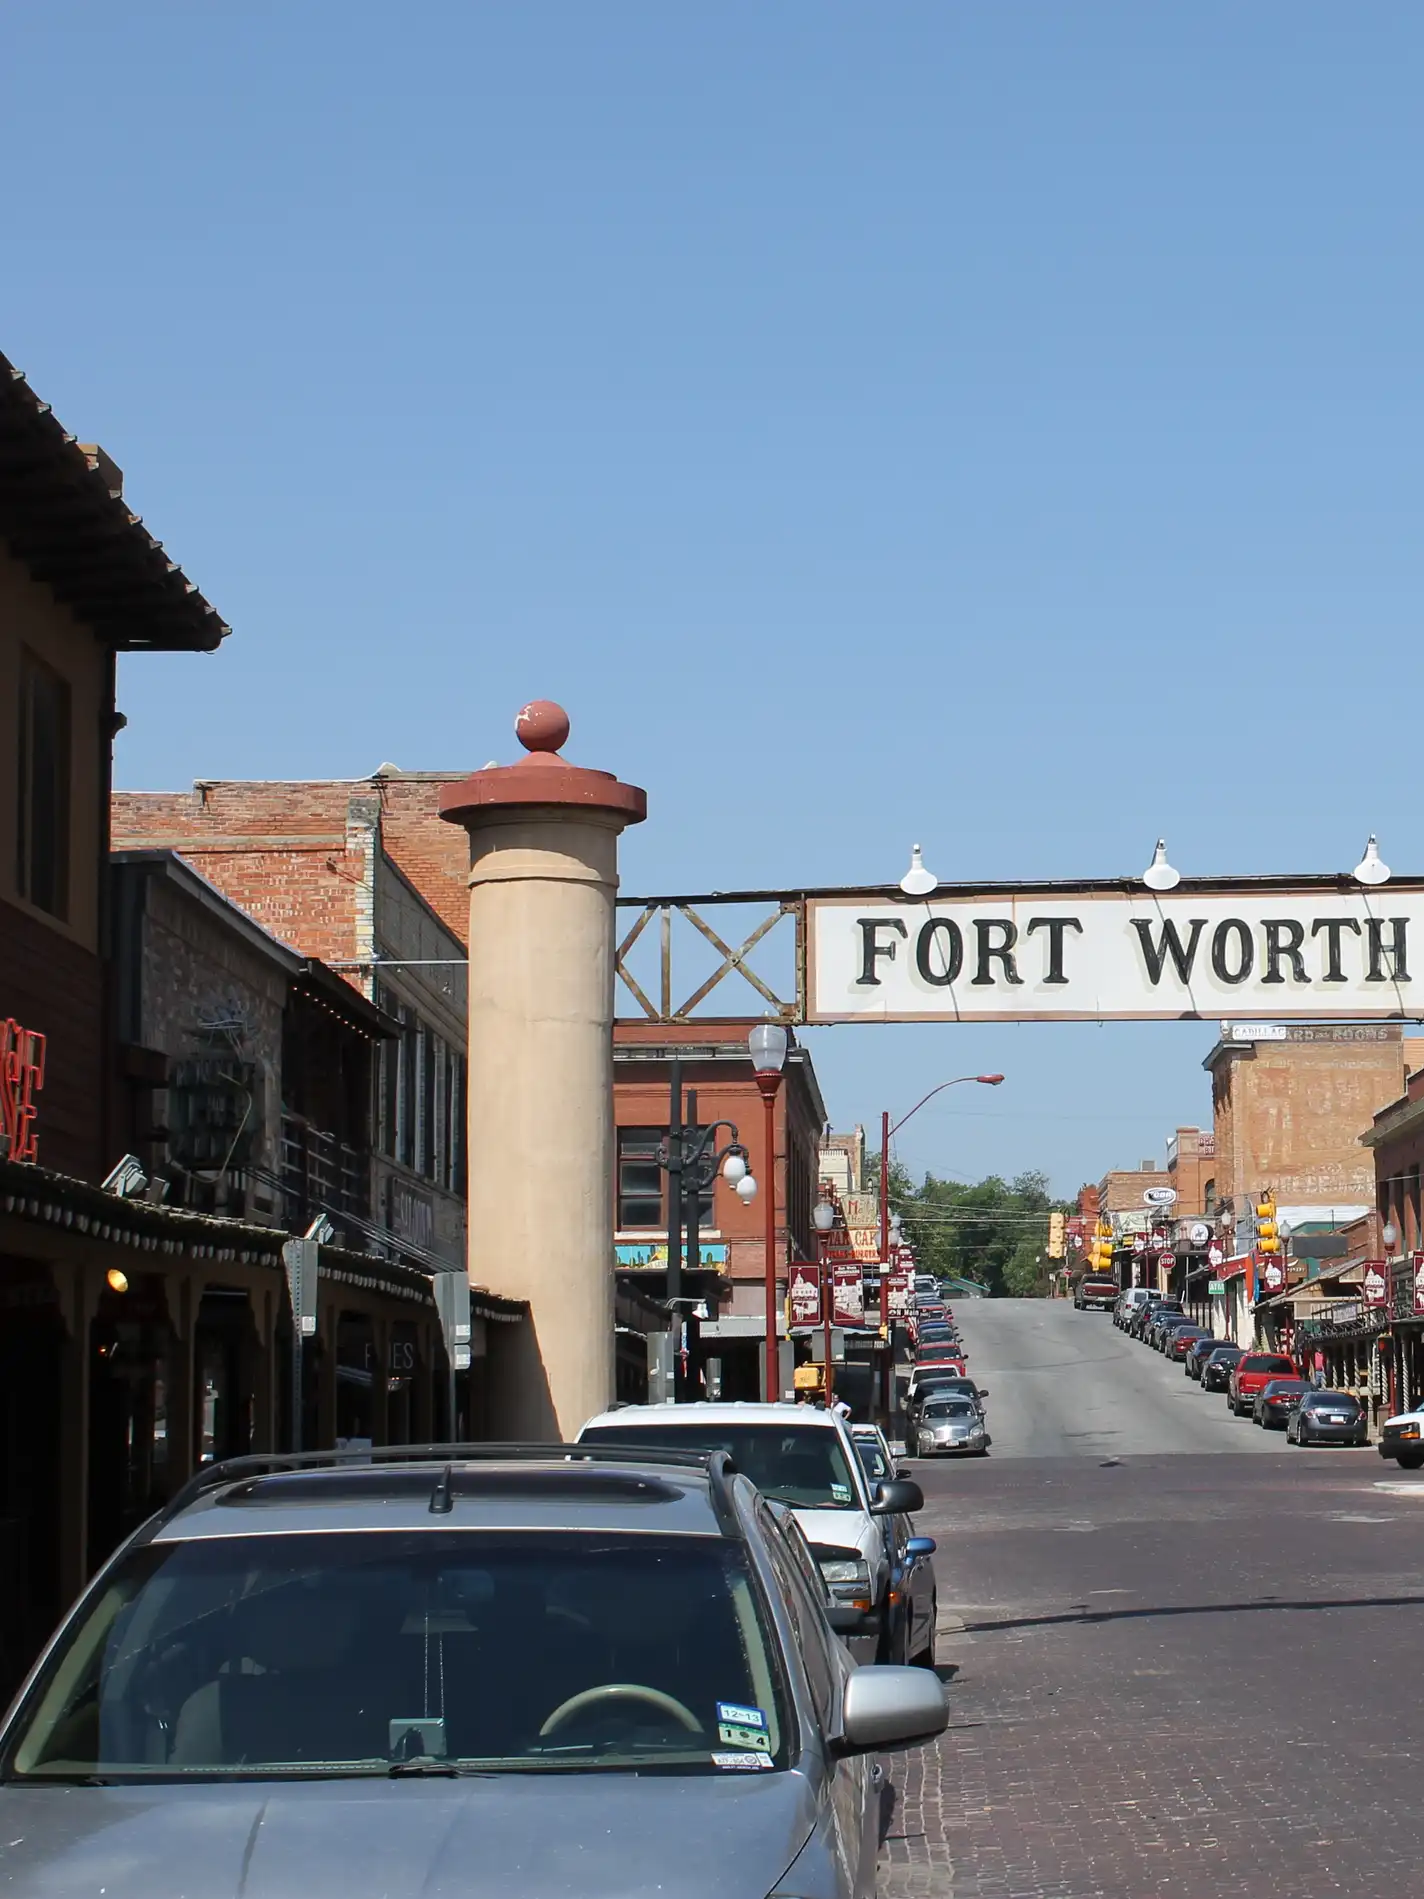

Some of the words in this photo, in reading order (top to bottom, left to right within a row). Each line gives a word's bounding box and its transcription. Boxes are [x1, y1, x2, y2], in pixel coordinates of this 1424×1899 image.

[857, 917, 1083, 985] FORT
[1131, 918, 1409, 984] WORTH
[1234, 1026, 1286, 1038] CADILLAC
[1332, 1027, 1389, 1041] ROOMS
[1210, 1282, 1224, 1291] ATM
